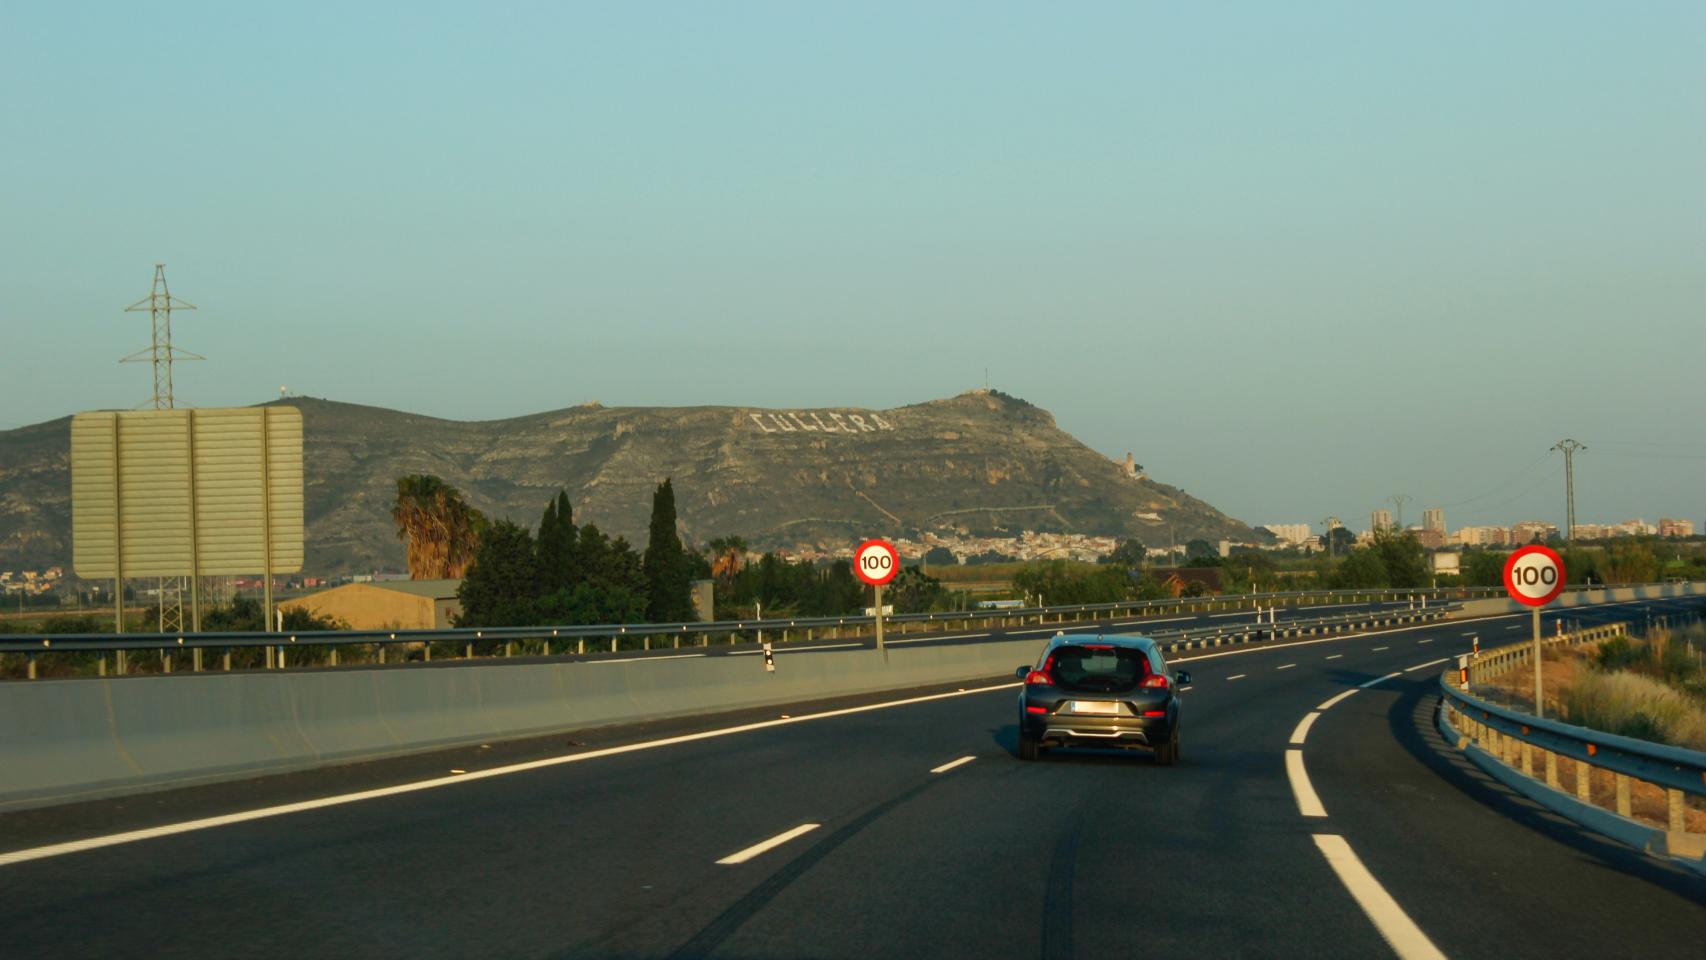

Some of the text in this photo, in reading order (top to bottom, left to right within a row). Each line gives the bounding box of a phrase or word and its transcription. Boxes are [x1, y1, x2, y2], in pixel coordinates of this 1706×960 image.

[749, 412, 895, 433] CULLERA
[862, 555, 891, 570] 100
[1514, 566, 1557, 586] 100
